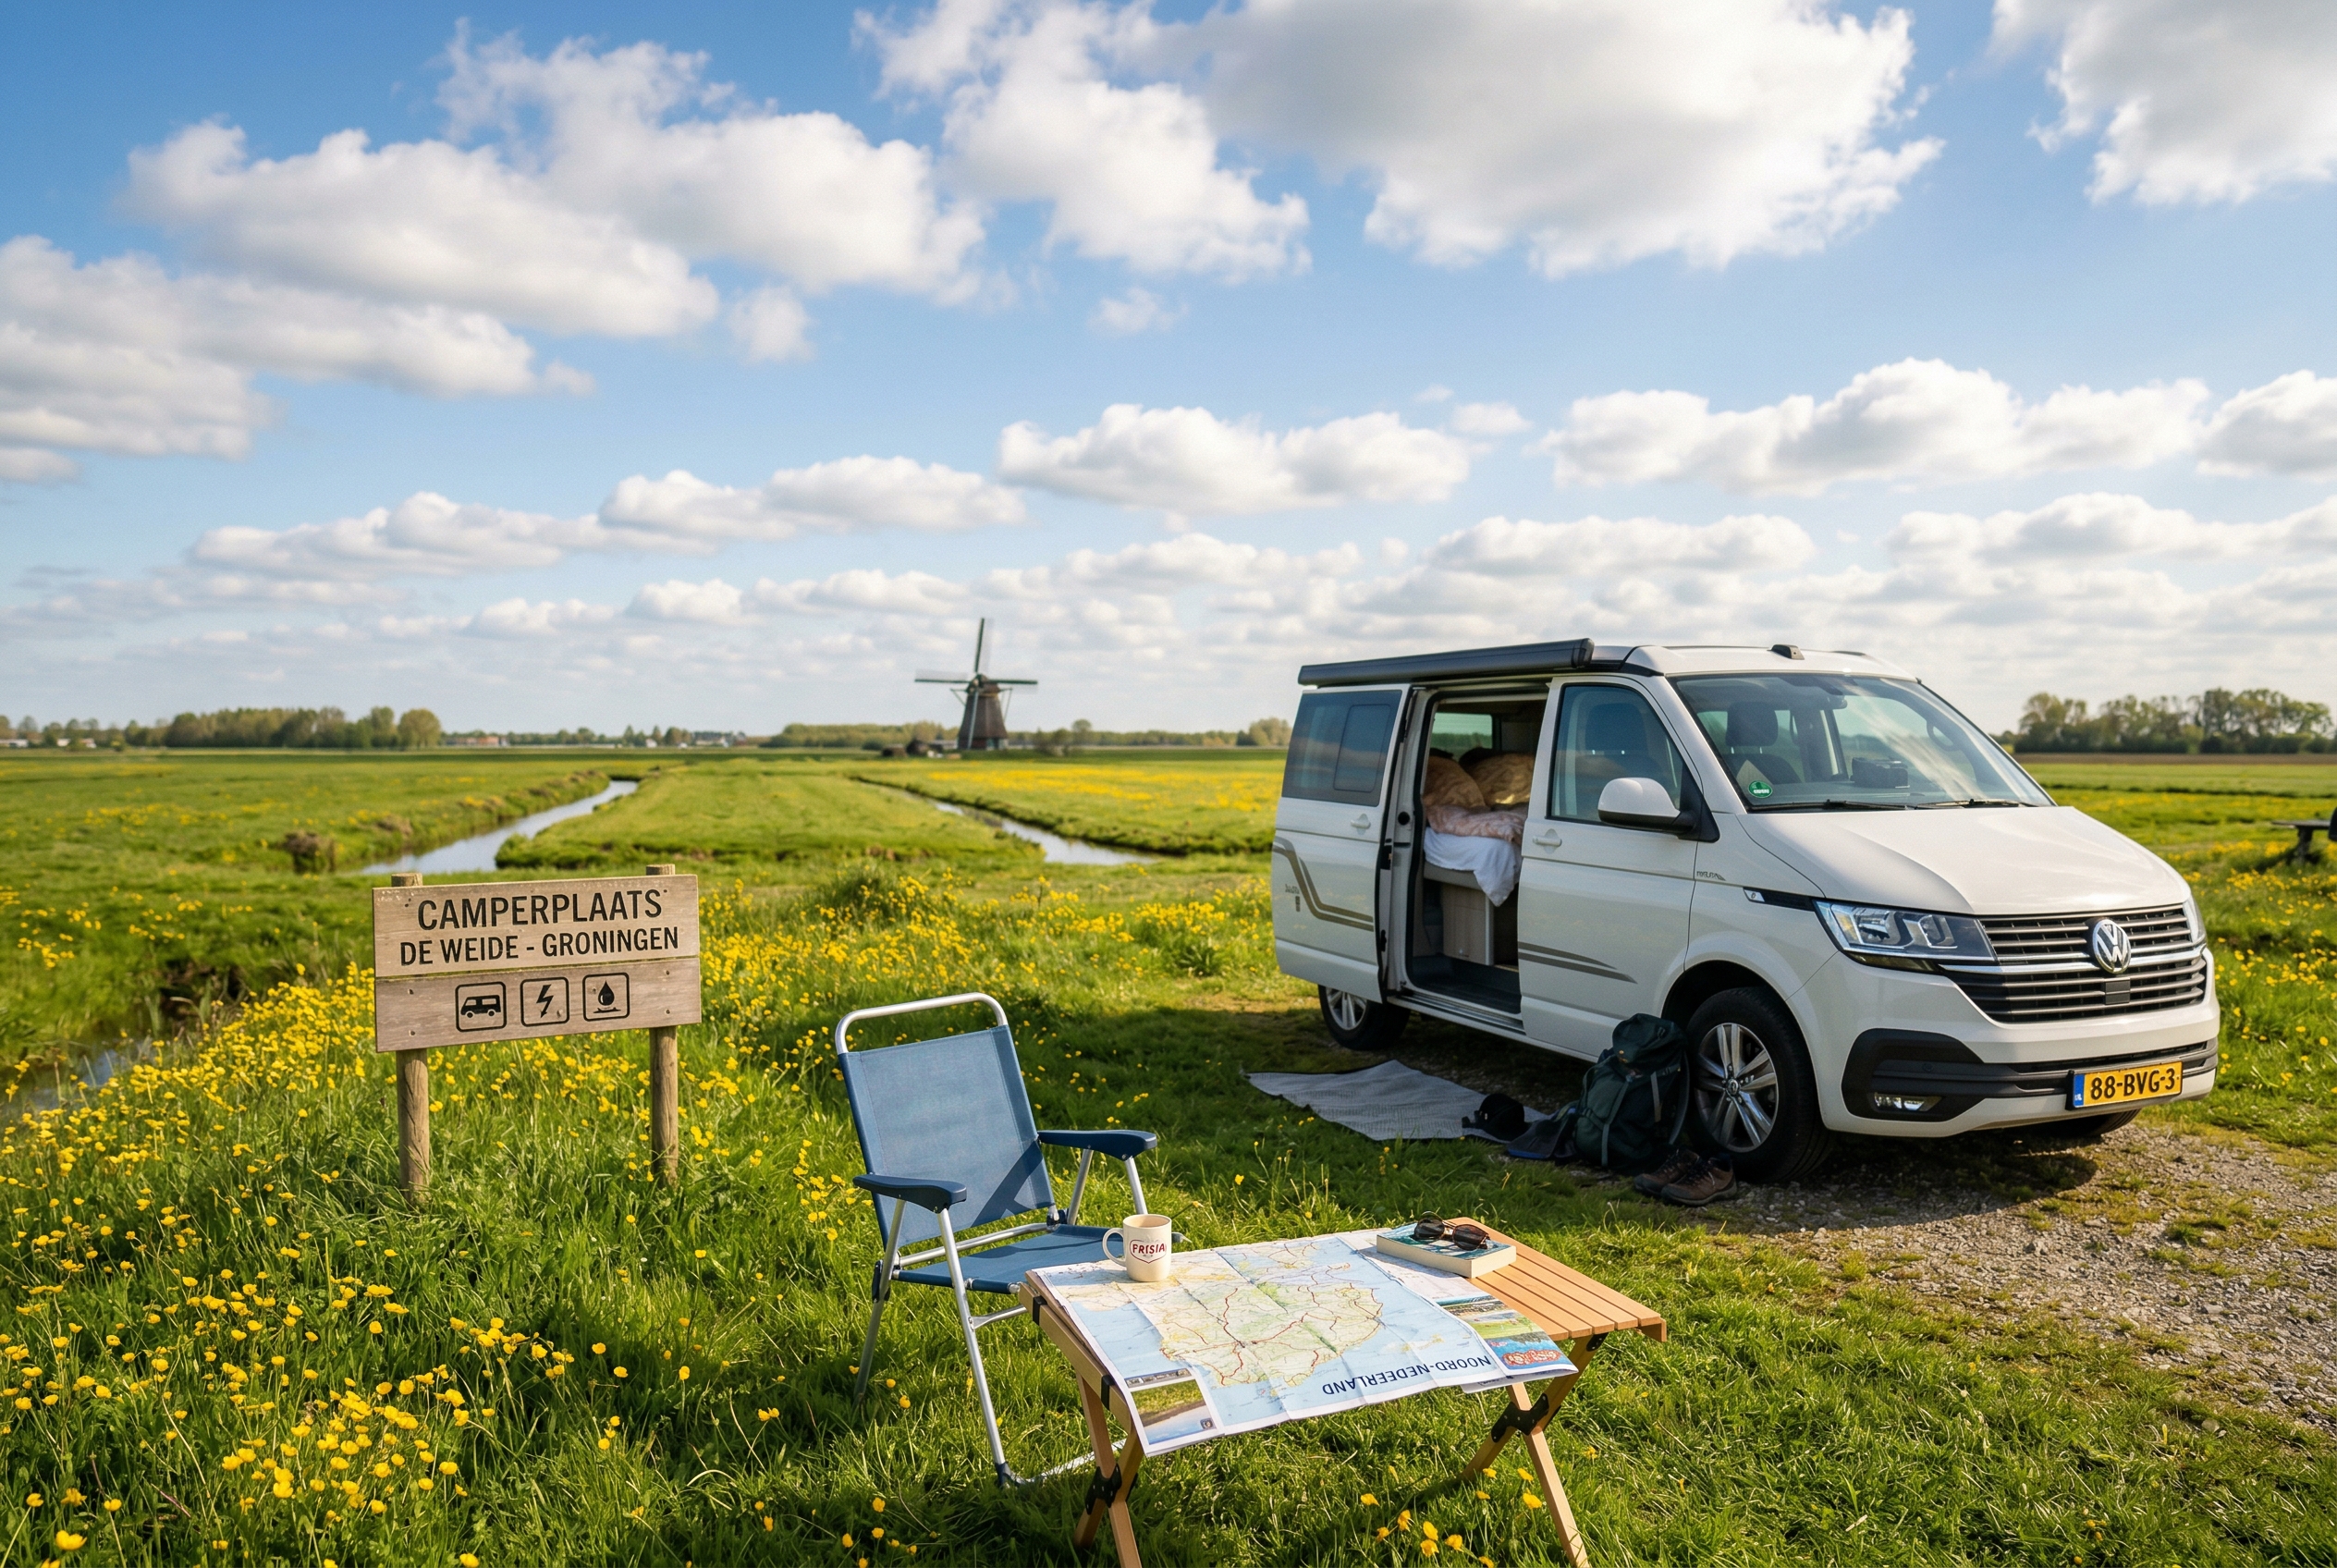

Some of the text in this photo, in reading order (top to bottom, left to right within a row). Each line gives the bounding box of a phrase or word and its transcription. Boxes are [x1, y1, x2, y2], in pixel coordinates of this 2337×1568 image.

[418, 888, 662, 931] CAMPERPLAATS
[400, 940, 434, 966] DE
[440, 935, 519, 963] WEIDE
[542, 926, 679, 957] GRONINGEN
[2090, 1068, 2175, 1100] 88-BVG-3
[1132, 1243, 1166, 1255] FRISIA
[1322, 1355, 1491, 1395] NOORD-NEDEERLAND
